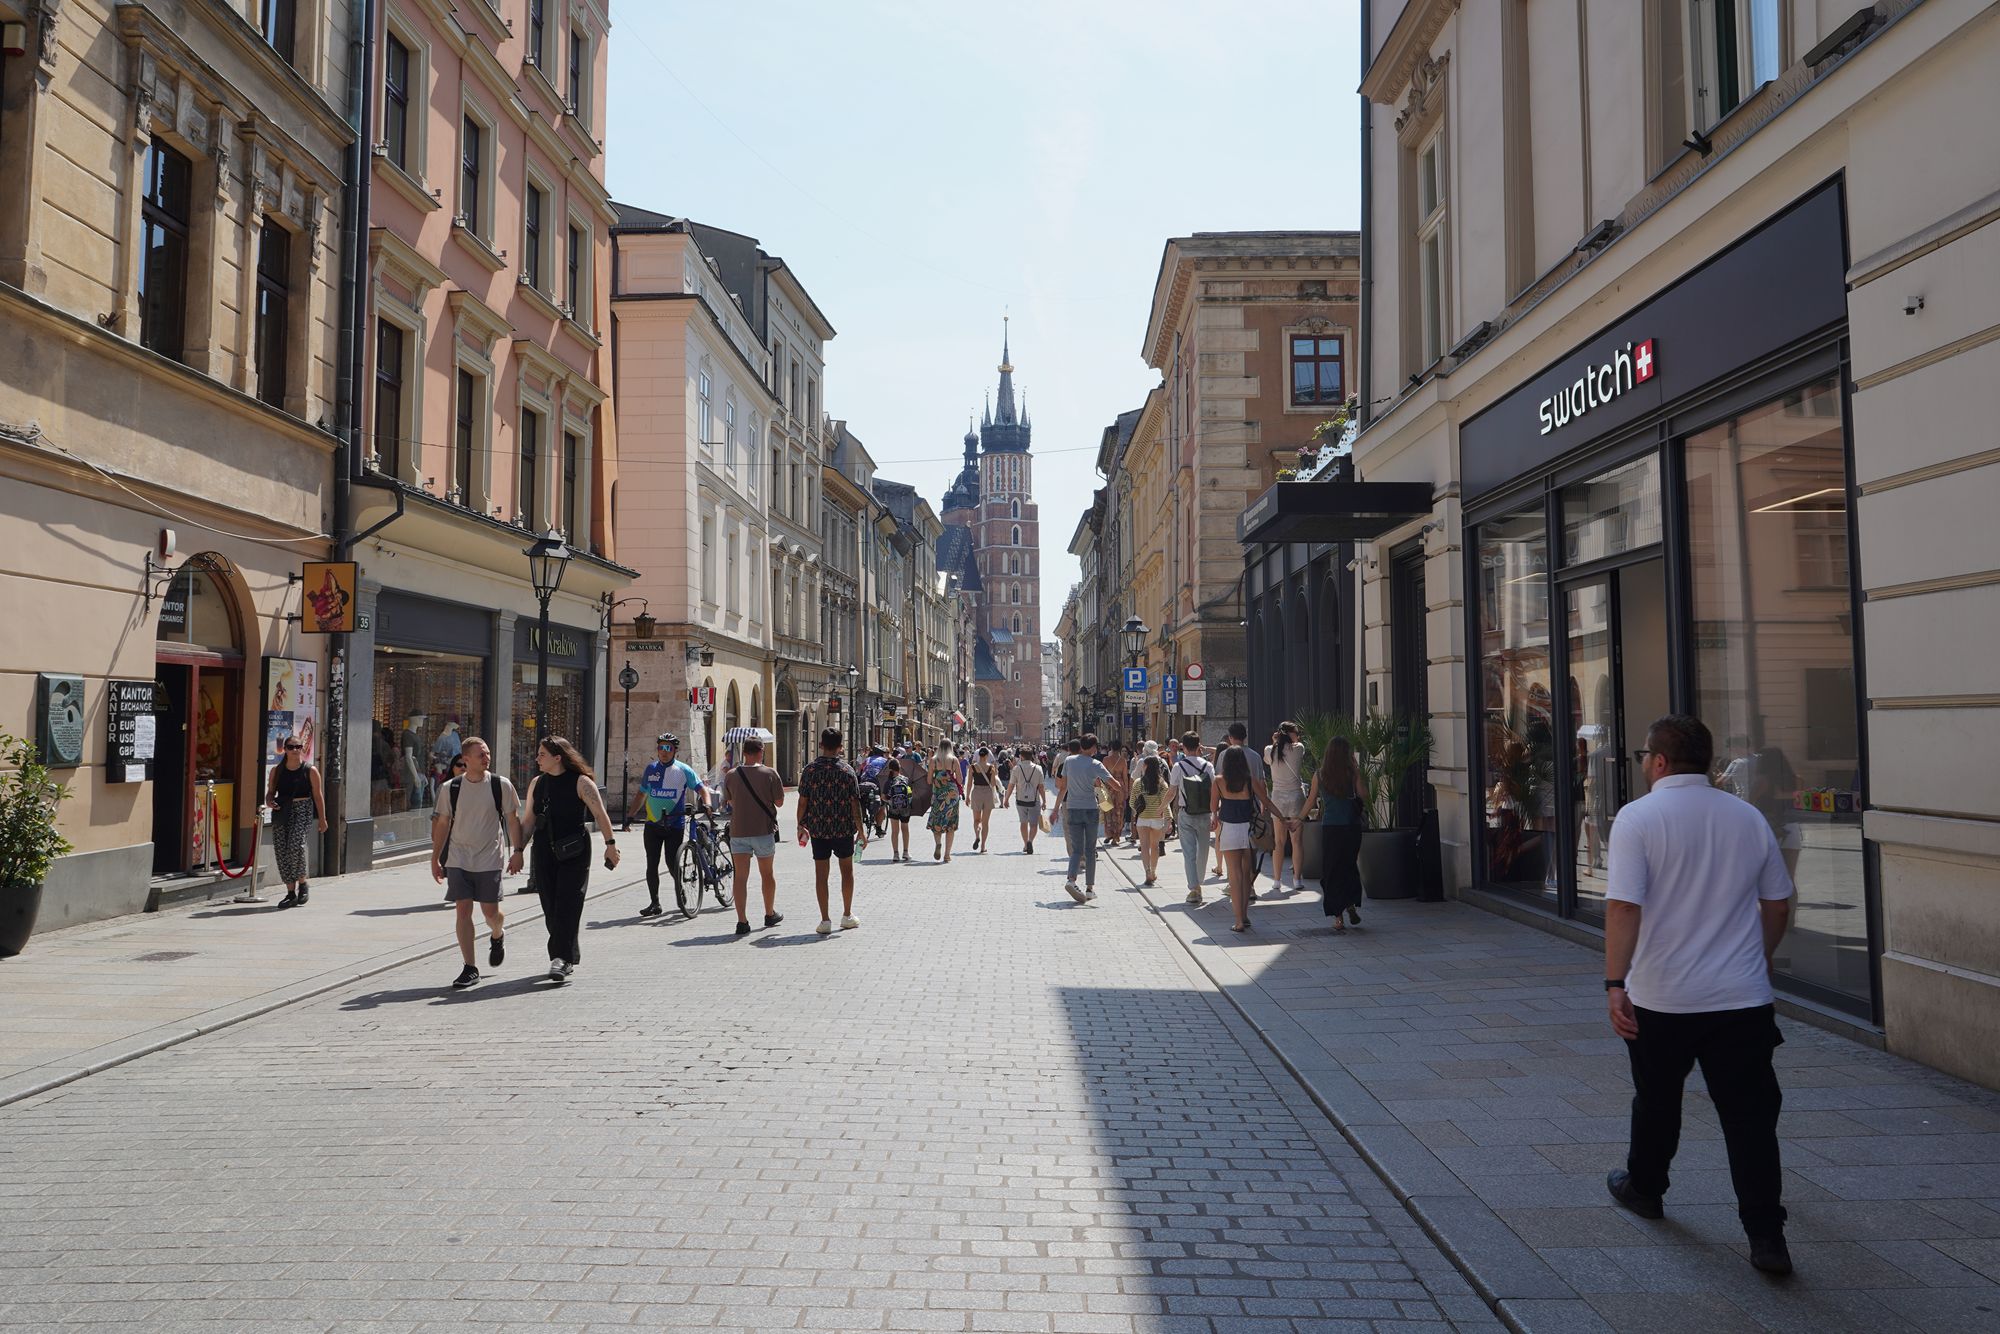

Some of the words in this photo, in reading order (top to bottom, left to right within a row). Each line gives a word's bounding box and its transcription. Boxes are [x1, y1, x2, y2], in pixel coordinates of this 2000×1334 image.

[1539, 349, 1632, 435] swatch
[1481, 554, 1548, 567] SCUBA
[162, 601, 185, 612] ANTOR
[360, 617, 369, 629] 35
[530, 627, 534, 651] I
[547, 631, 578, 657] Kraków
[1128, 670, 1142, 689] P
[120, 687, 153, 701] KANTOR
[1165, 690, 1174, 703] P
[108, 682, 118, 743] KANTOR
[120, 702, 153, 712] EXCHANGE
[119, 720, 135, 731] EUR
[119, 733, 135, 744] USD
[118, 745, 135, 756] GBP
